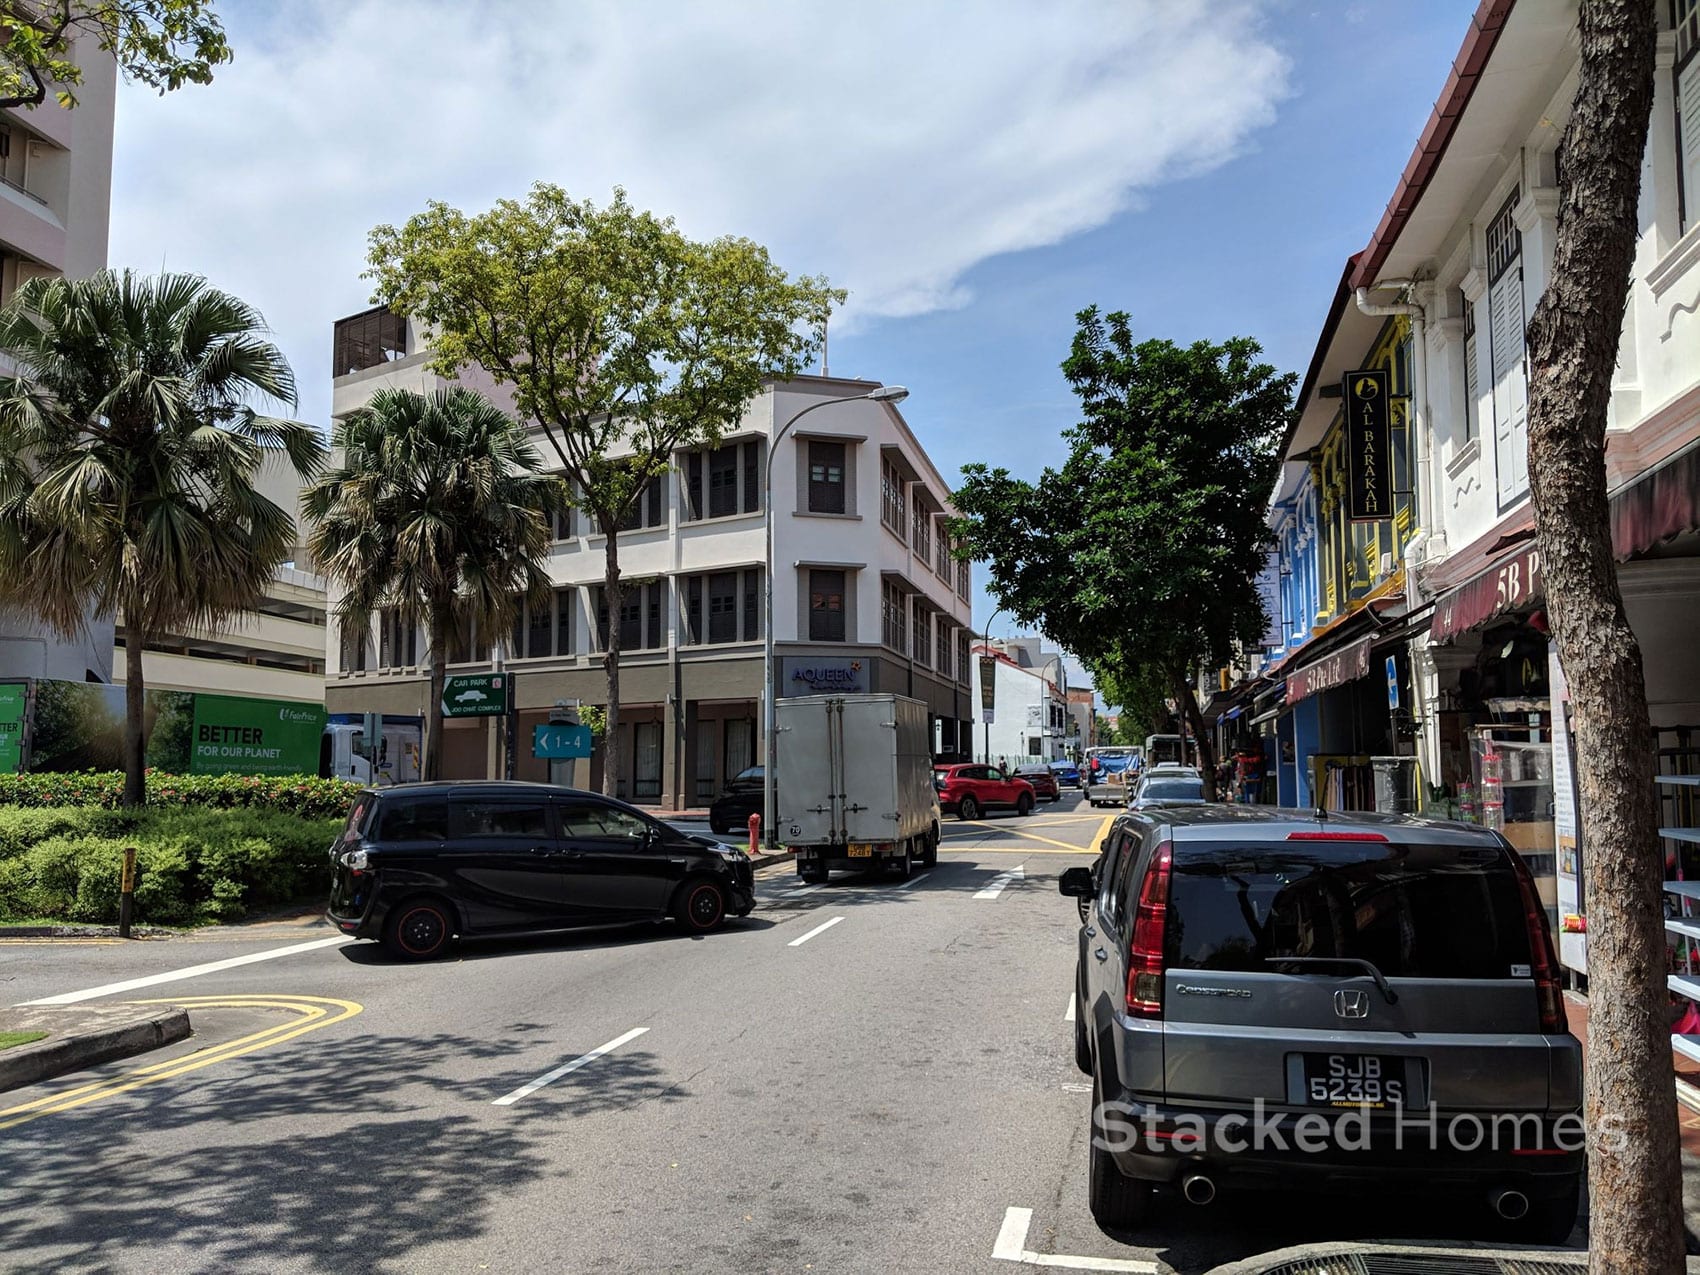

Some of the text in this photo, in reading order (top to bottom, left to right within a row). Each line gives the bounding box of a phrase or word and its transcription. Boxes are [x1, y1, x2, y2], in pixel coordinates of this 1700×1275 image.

[1362, 402, 1378, 512] AL BARAKAH
[1496, 561, 1520, 609] 5B
[453, 679, 489, 688] CAR PARK
[792, 667, 857, 683] AQUEEN
[289, 710, 317, 721] FairPrice
[199, 724, 264, 745] BETTER
[197, 746, 281, 759] FOR OUR PLANET
[1329, 1055, 1381, 1078] SJB
